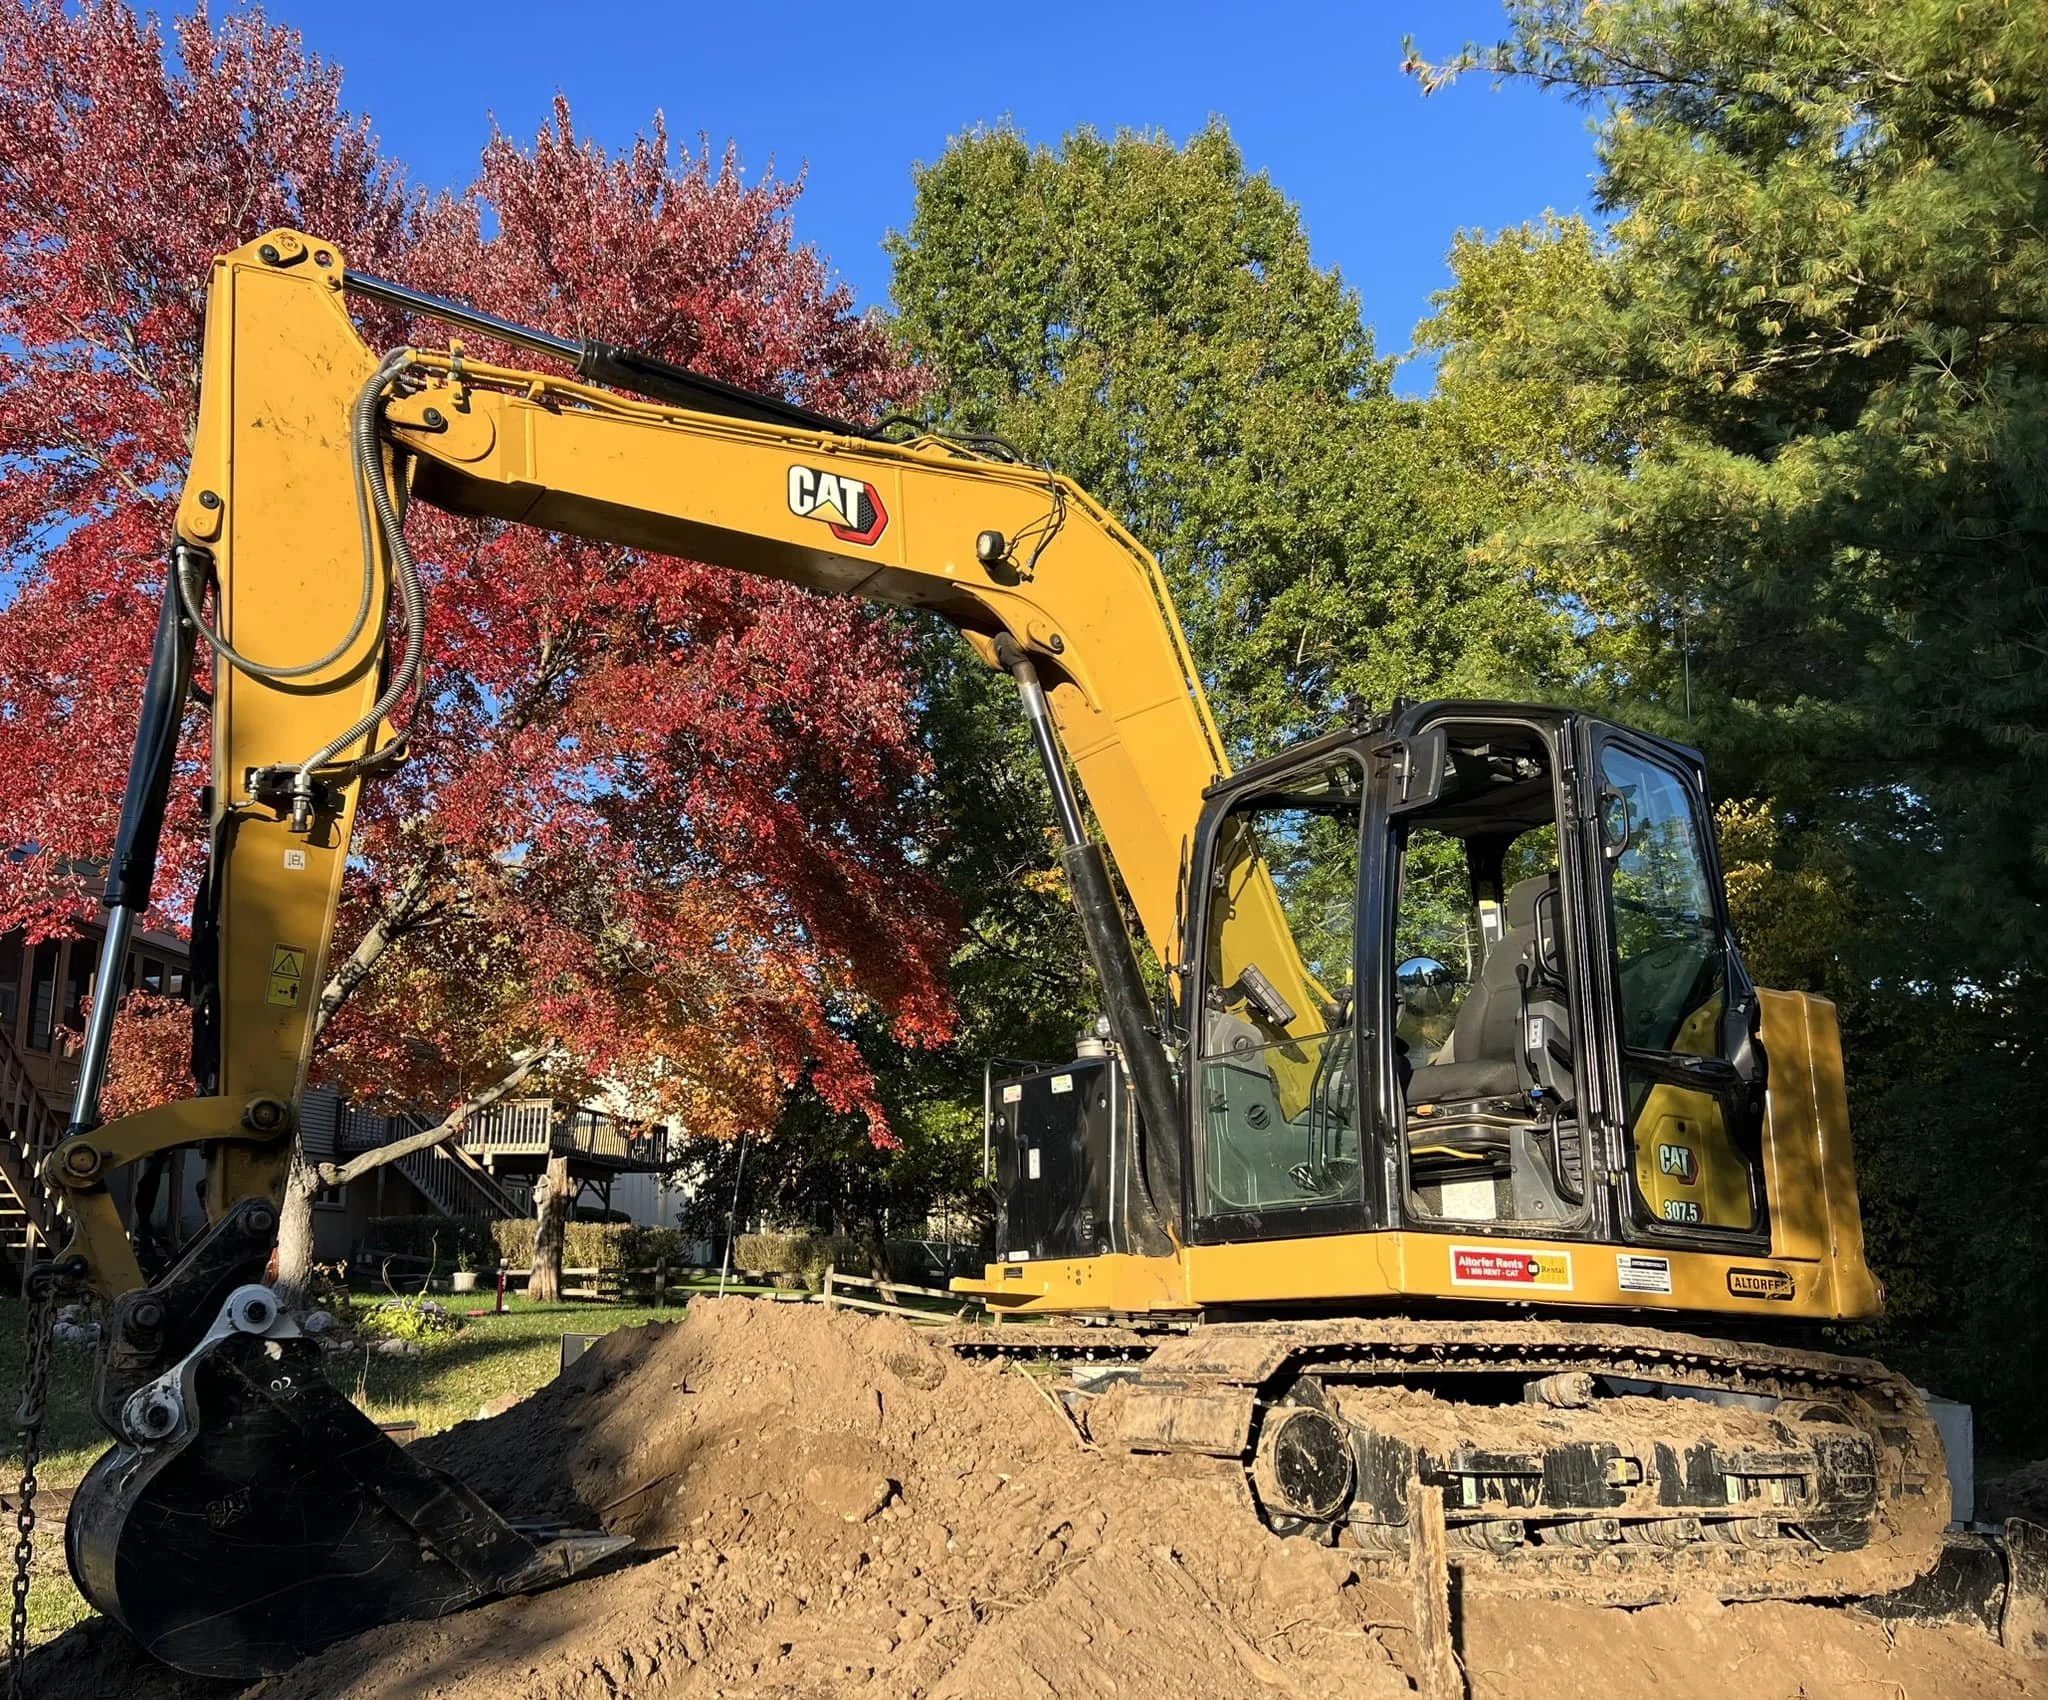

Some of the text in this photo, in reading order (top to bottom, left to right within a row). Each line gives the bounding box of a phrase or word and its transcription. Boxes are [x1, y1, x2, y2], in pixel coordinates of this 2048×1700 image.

[788, 465, 865, 529] CAT
[1660, 1144, 1689, 1176] CAT
[1664, 1200, 1698, 1222] 307.5
[1458, 1256, 1495, 1267] Altorfer
[1495, 1258, 1524, 1269] Rents
[1541, 1265, 1565, 1274] Rental
